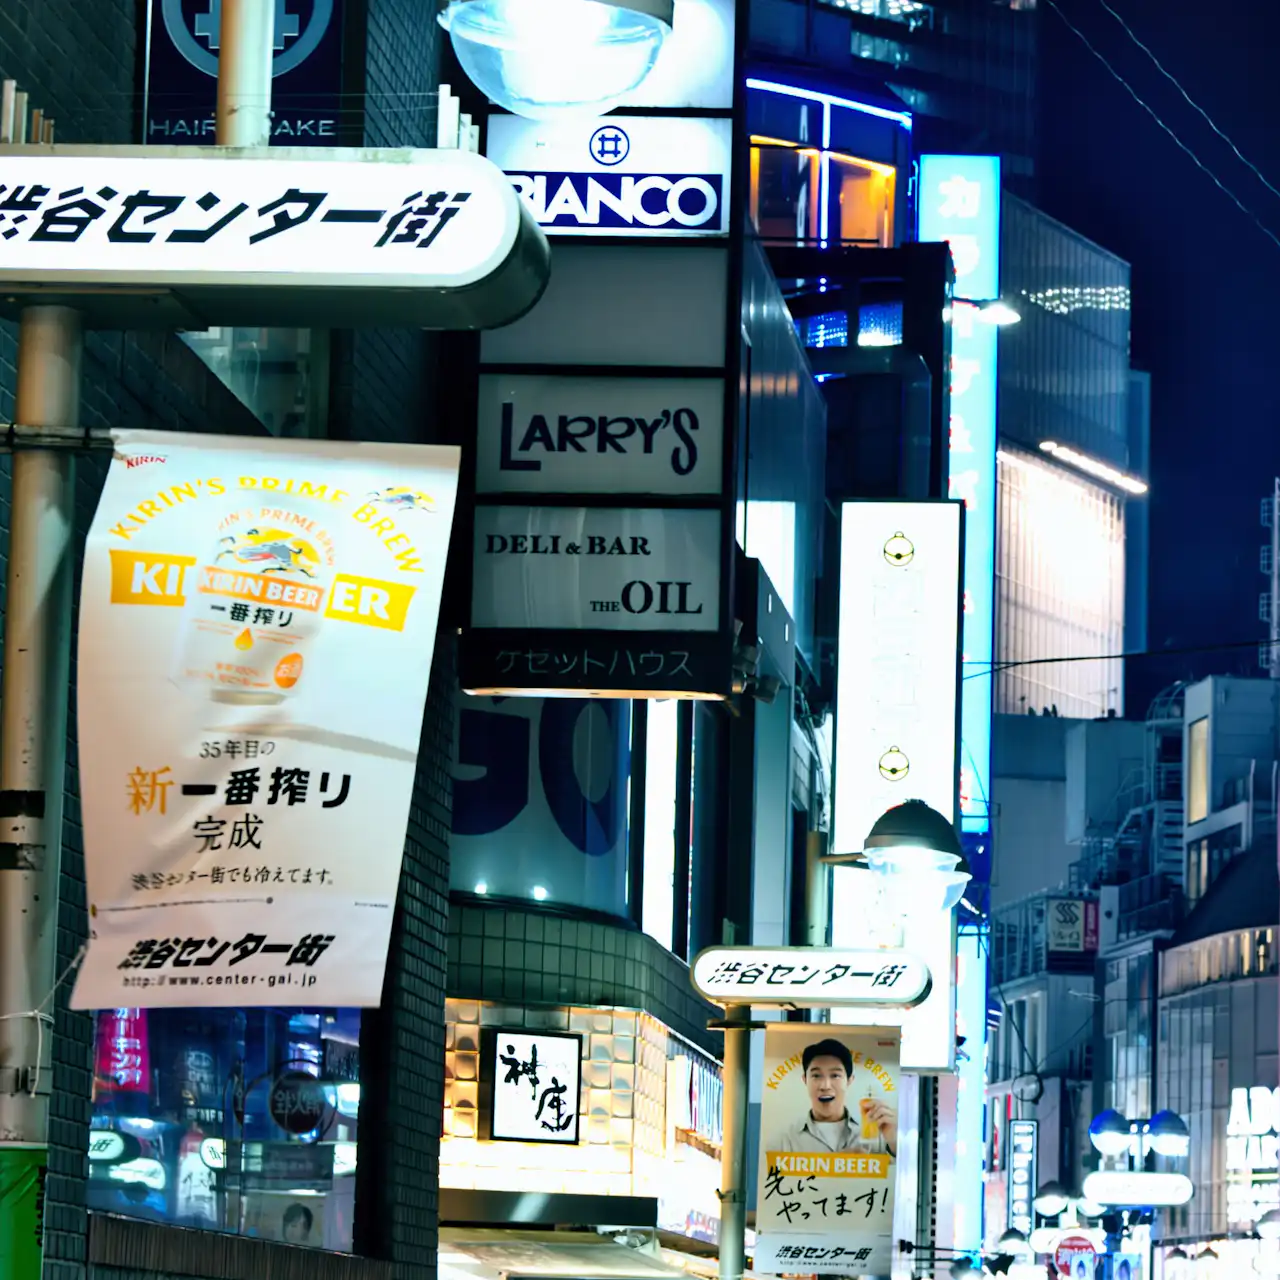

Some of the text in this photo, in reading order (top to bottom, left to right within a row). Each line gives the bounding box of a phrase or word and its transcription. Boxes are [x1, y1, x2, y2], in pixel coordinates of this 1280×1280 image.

[272, 119, 336, 136] AKE
[500, 402, 699, 475] LARRY'S
[352, 503, 425, 574] BREW
[485, 534, 651, 555] DELI & BAR
[265, 584, 318, 608] BEER
[590, 580, 703, 614] THE OIL
[193, 813, 264, 853] 完成
[117, 933, 336, 970] 渋谷センター街
[709, 962, 907, 988] 渋谷センター街
[775, 1156, 881, 1174] KIRIN BEER
[765, 1166, 819, 1200] 先に
[775, 1246, 873, 1261] 渋谷センター街
